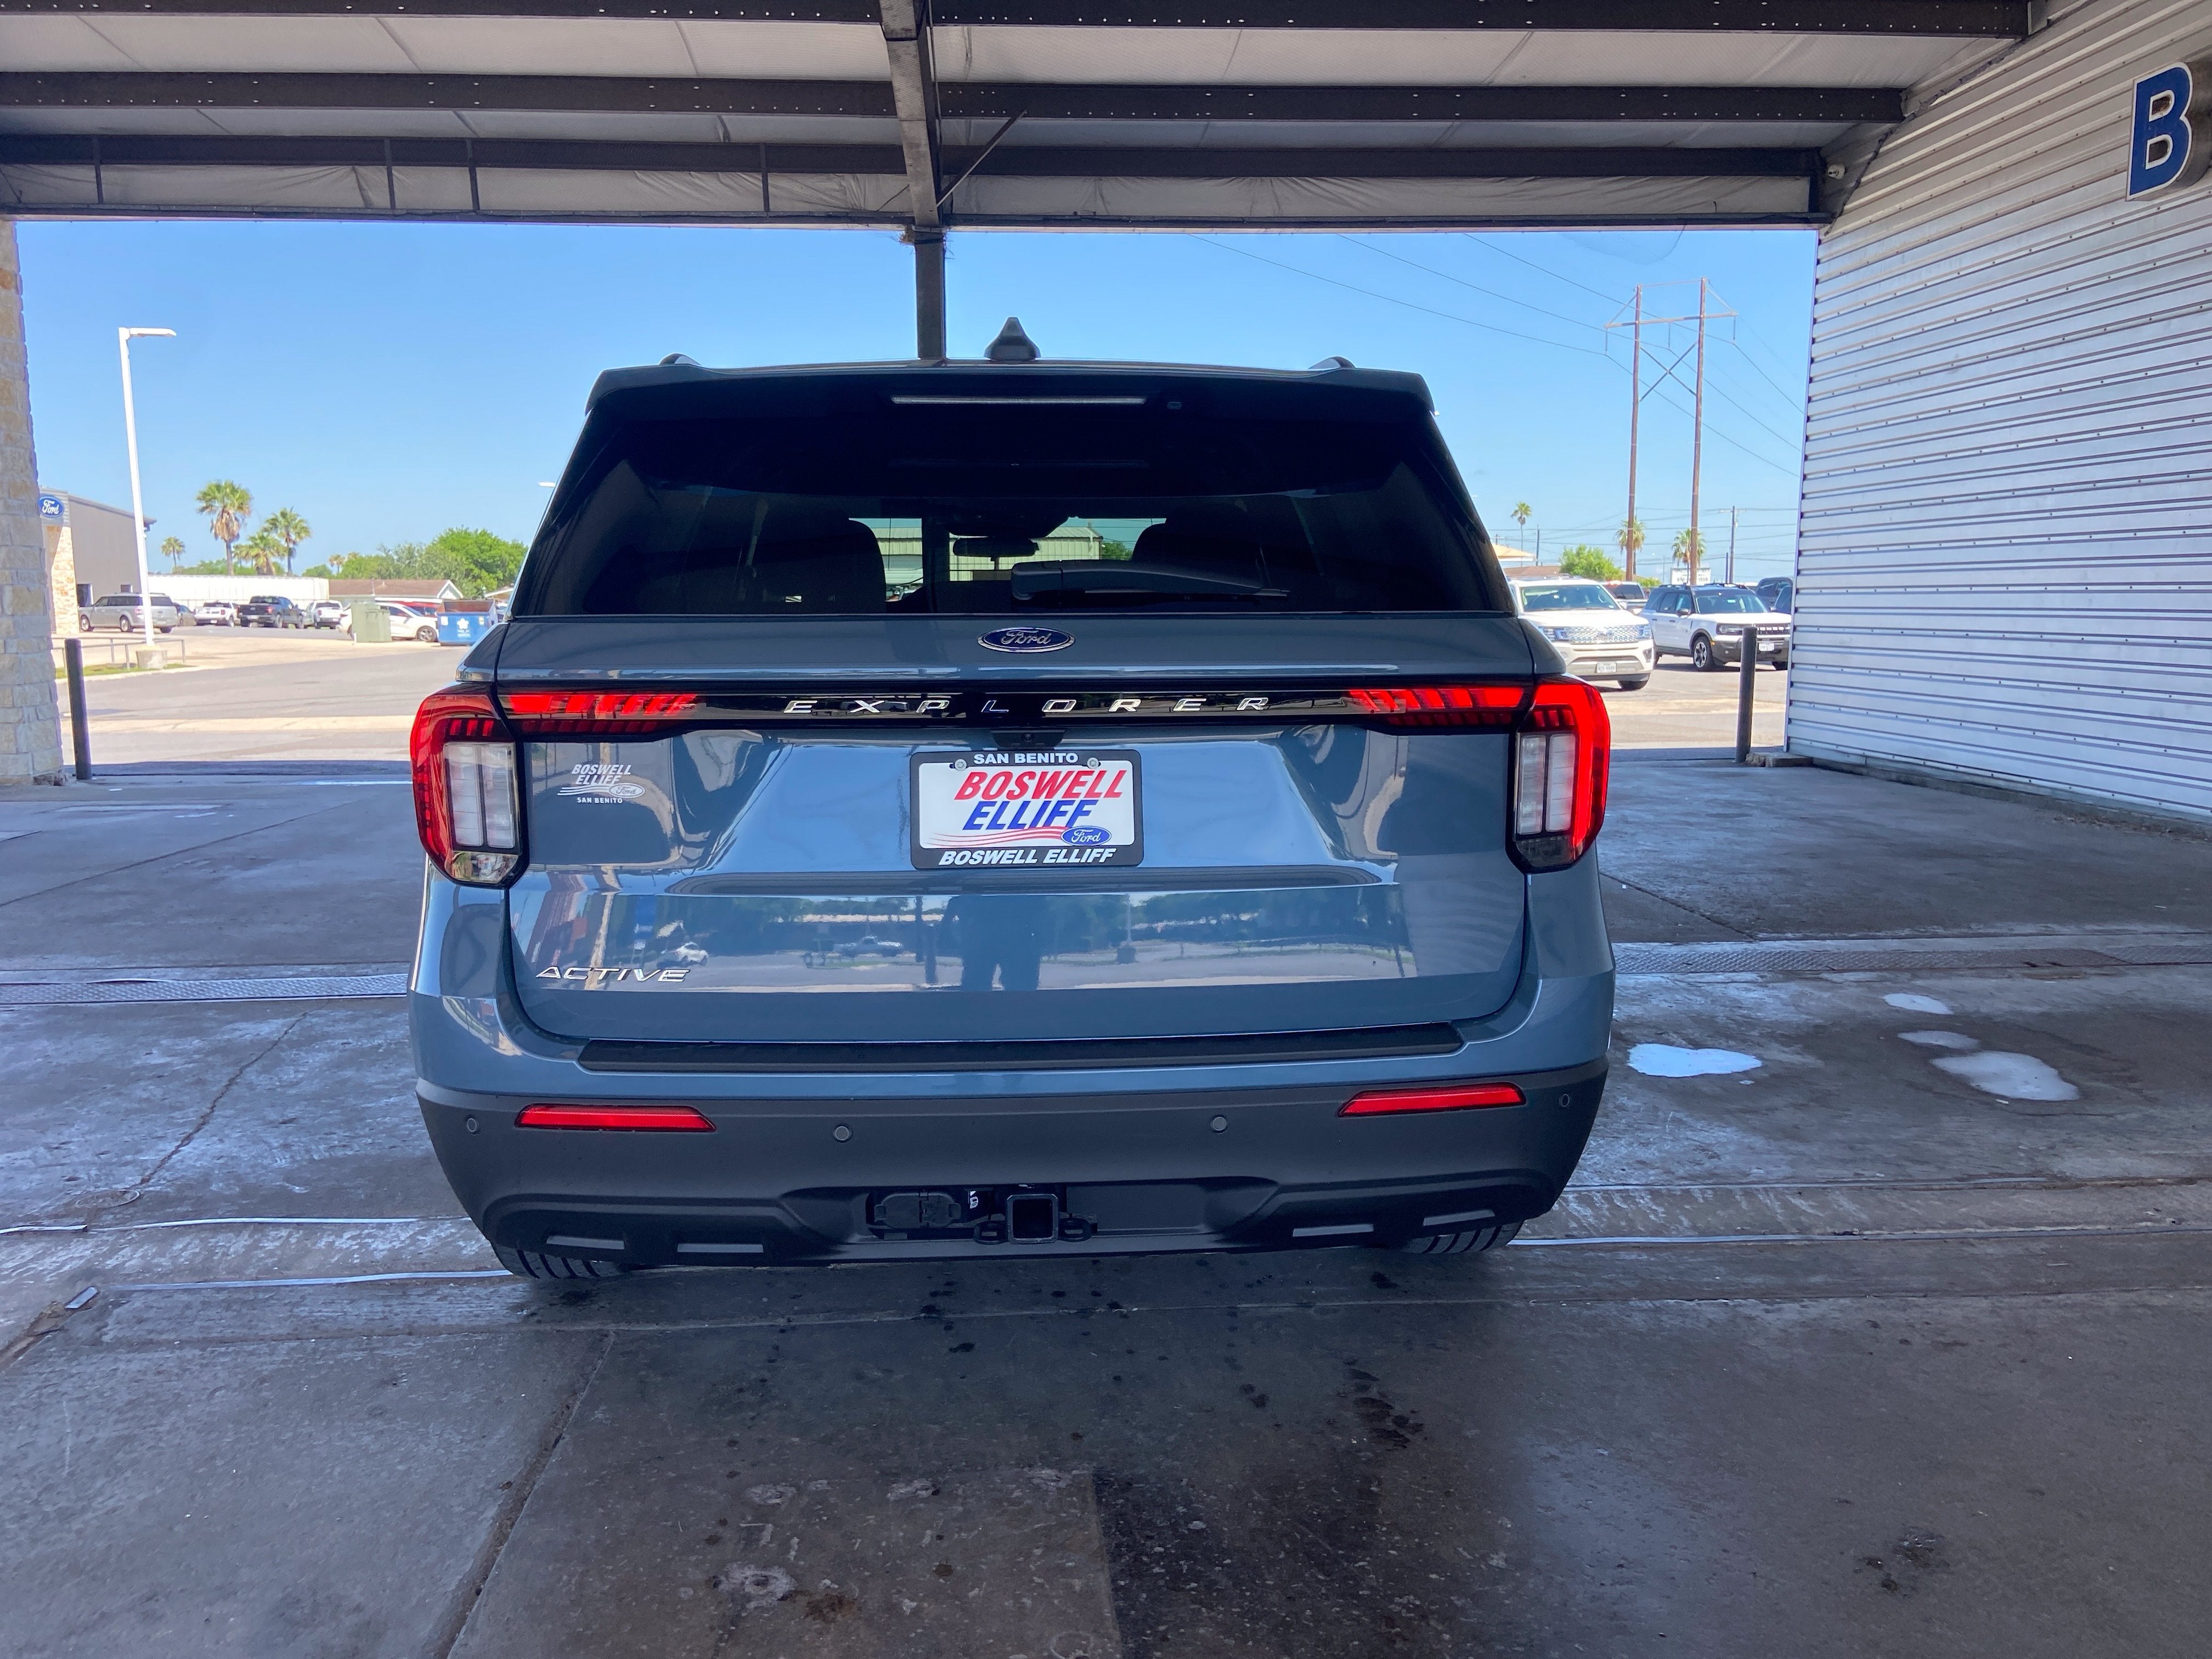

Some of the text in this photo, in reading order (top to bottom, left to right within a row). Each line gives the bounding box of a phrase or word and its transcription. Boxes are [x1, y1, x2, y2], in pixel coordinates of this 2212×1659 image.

[2125, 61, 2193, 201] B
[42, 499, 60, 514] Ford
[1000, 630, 1052, 645] Ford
[783, 697, 1269, 714] EXPLORER
[973, 752, 1079, 765] SAN BENITO
[571, 764, 631, 775] BOSWELL
[575, 775, 623, 785] ELLIFF
[953, 770, 1127, 800] BOSWELL
[616, 786, 637, 795] Ford
[962, 799, 1099, 830] ELLIFF
[1070, 829, 1102, 843] Ford
[938, 848, 1117, 866] BOSWELL ELLIFF
[535, 966, 690, 982] ACTIVE
